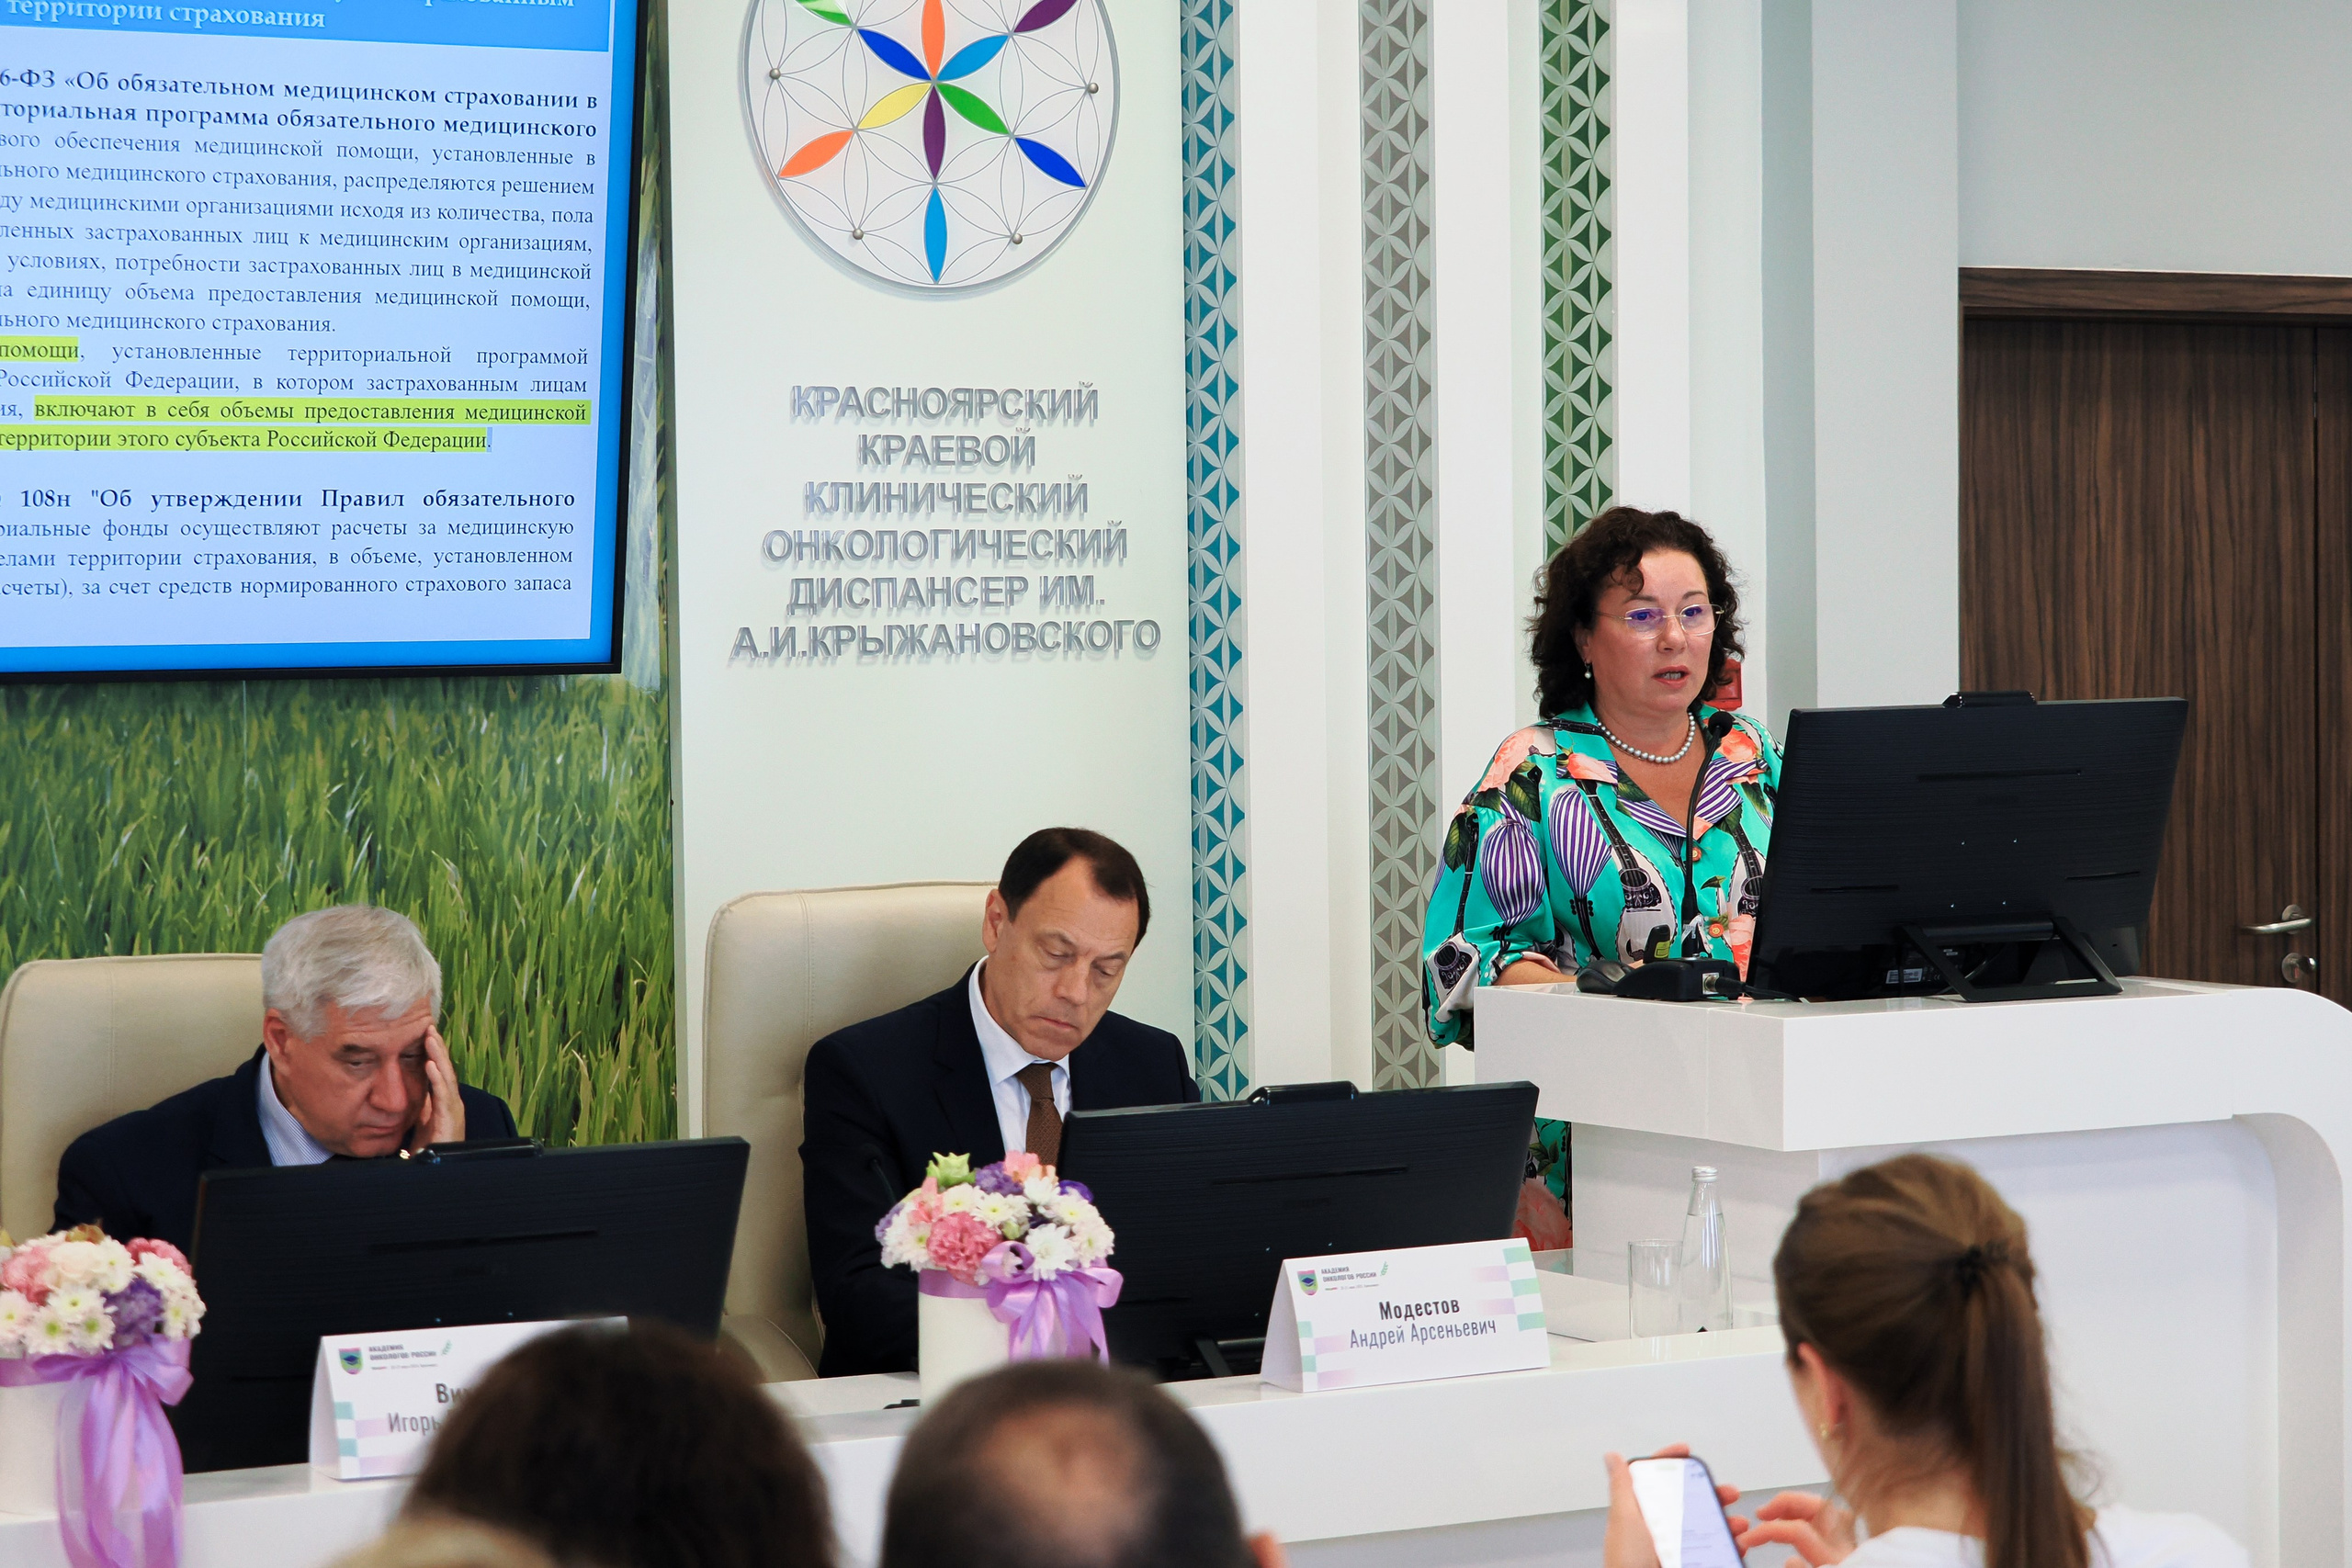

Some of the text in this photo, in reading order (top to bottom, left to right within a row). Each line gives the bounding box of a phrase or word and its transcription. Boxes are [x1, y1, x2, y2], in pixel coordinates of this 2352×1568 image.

[7, 0, 325, 28] территории страхования
[117, 72, 276, 97] обязательном
[283, 83, 436, 104] медицинском
[444, 89, 579, 111] страховании
[586, 95, 598, 109] в
[0, 102, 597, 138] ториальная программа обязательного медицинского
[0, 130, 596, 166] вого обеспечения медицинской помощи, установленные в
[65, 165, 207, 184] медицинского
[212, 170, 338, 191] страхования,
[343, 175, 496, 195] распределяются
[501, 179, 594, 197] решением
[29, 195, 180, 213] медицинскими
[186, 199, 334, 220] организациями
[340, 203, 404, 220] исходя
[410, 206, 431, 220] из
[436, 206, 546, 226] количества,
[551, 209, 594, 224] пола
[0, 224, 593, 256] ленных застрахованных лиц к медицинским организациям,
[6, 252, 592, 280] условиях, потребности застрахованных лиц в медицинской
[27, 284, 112, 305] единицу
[124, 281, 195, 301] объема
[208, 288, 362, 308] предоставления
[374, 288, 499, 308] медицинской
[510, 293, 590, 311] помощи,
[66, 314, 206, 331] медицинского
[211, 317, 336, 336] страхования.
[0, 344, 589, 369] помощи, установленные территориальной программой
[125, 369, 240, 394] Федерации,
[253, 376, 264, 389] в
[276, 376, 355, 396] котором
[366, 377, 519, 397] застрахованным
[529, 378, 588, 395] лицам
[34, 402, 137, 418] включают
[145, 403, 157, 418] в
[167, 399, 210, 419] себя
[220, 399, 295, 419] объемы
[304, 405, 456, 424] предоставления
[464, 402, 587, 423] медицинской
[790, 381, 1099, 420] КРАСНОЯРСКИЙ
[117, 433, 170, 447] этого
[175, 427, 261, 452] субъекта
[266, 428, 378, 448] Российской
[382, 425, 493, 454] Федерации.
[858, 427, 1036, 468] КРАЕВОЙ
[20, 488, 72, 508] 108н
[150, 492, 303, 513] утверждении
[320, 488, 405, 513] Правил
[423, 488, 575, 508] обязательного
[804, 473, 1089, 514] КЛИНИЧЕСКИЙ
[102, 517, 169, 542] фонды
[180, 522, 322, 541] осуществляют
[330, 522, 408, 541] расчеты
[417, 522, 437, 536] за
[447, 521, 574, 540] медицинскую
[762, 520, 1128, 562] ОНКОЛОГИЧЕСКИЙ
[67, 552, 183, 572] территории
[193, 551, 317, 571] страхования,
[328, 551, 339, 565] в
[350, 546, 423, 568] объеме,
[433, 549, 573, 569] установленном
[81, 581, 101, 595] за
[108, 581, 152, 595] счет
[158, 581, 232, 600] средств
[240, 579, 398, 599] нормированного
[405, 577, 507, 597] страхового
[513, 577, 572, 592] запаса
[786, 575, 1105, 616] ДИСПАНСЕР ИМ.
[729, 619, 1161, 660] А.И.КРЫЖАНОВСКОГО
[1378, 1298, 1460, 1321] Модестов
[1350, 1319, 1497, 1350] Андрей Арсеньевич
